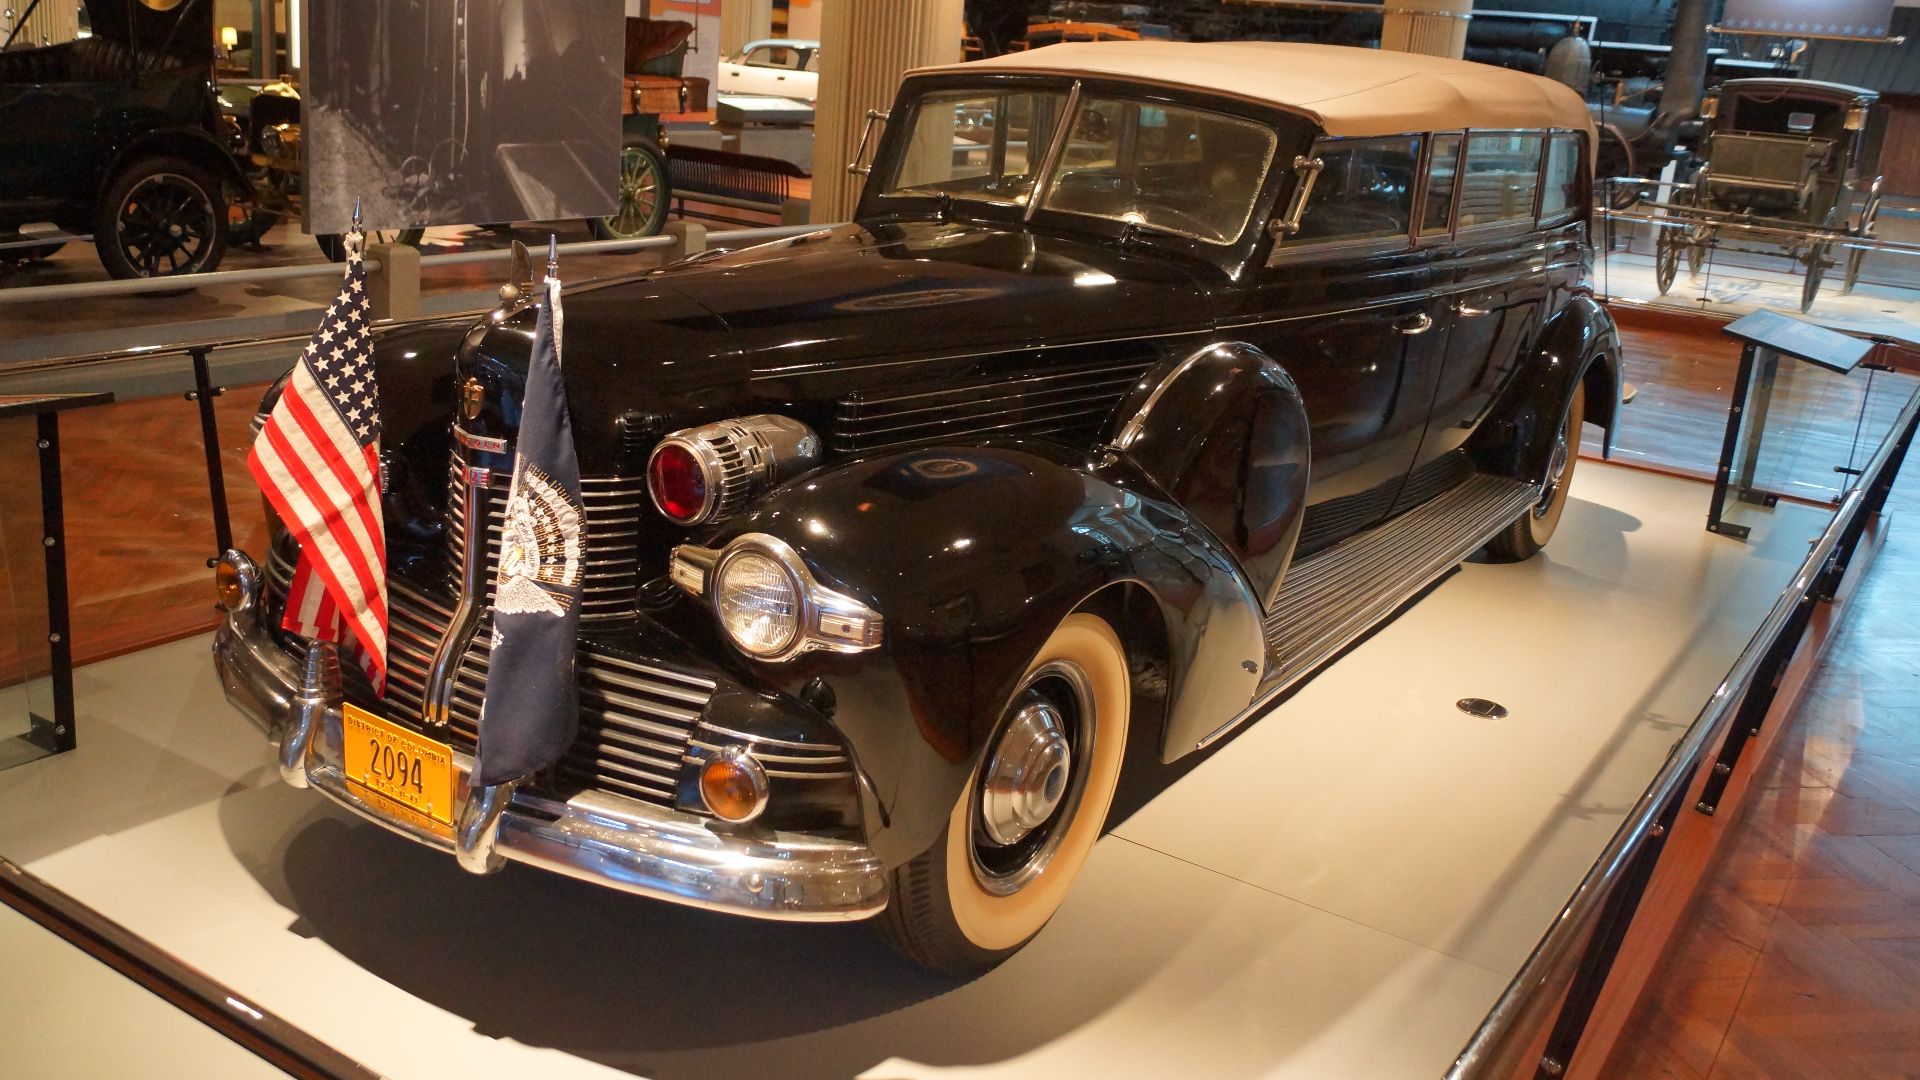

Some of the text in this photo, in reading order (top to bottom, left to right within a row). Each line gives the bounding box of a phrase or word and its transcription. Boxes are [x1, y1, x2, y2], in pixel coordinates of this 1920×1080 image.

[348, 716, 445, 765] DISTRICT OF COLUMBIA
[371, 739, 422, 794] 2094
